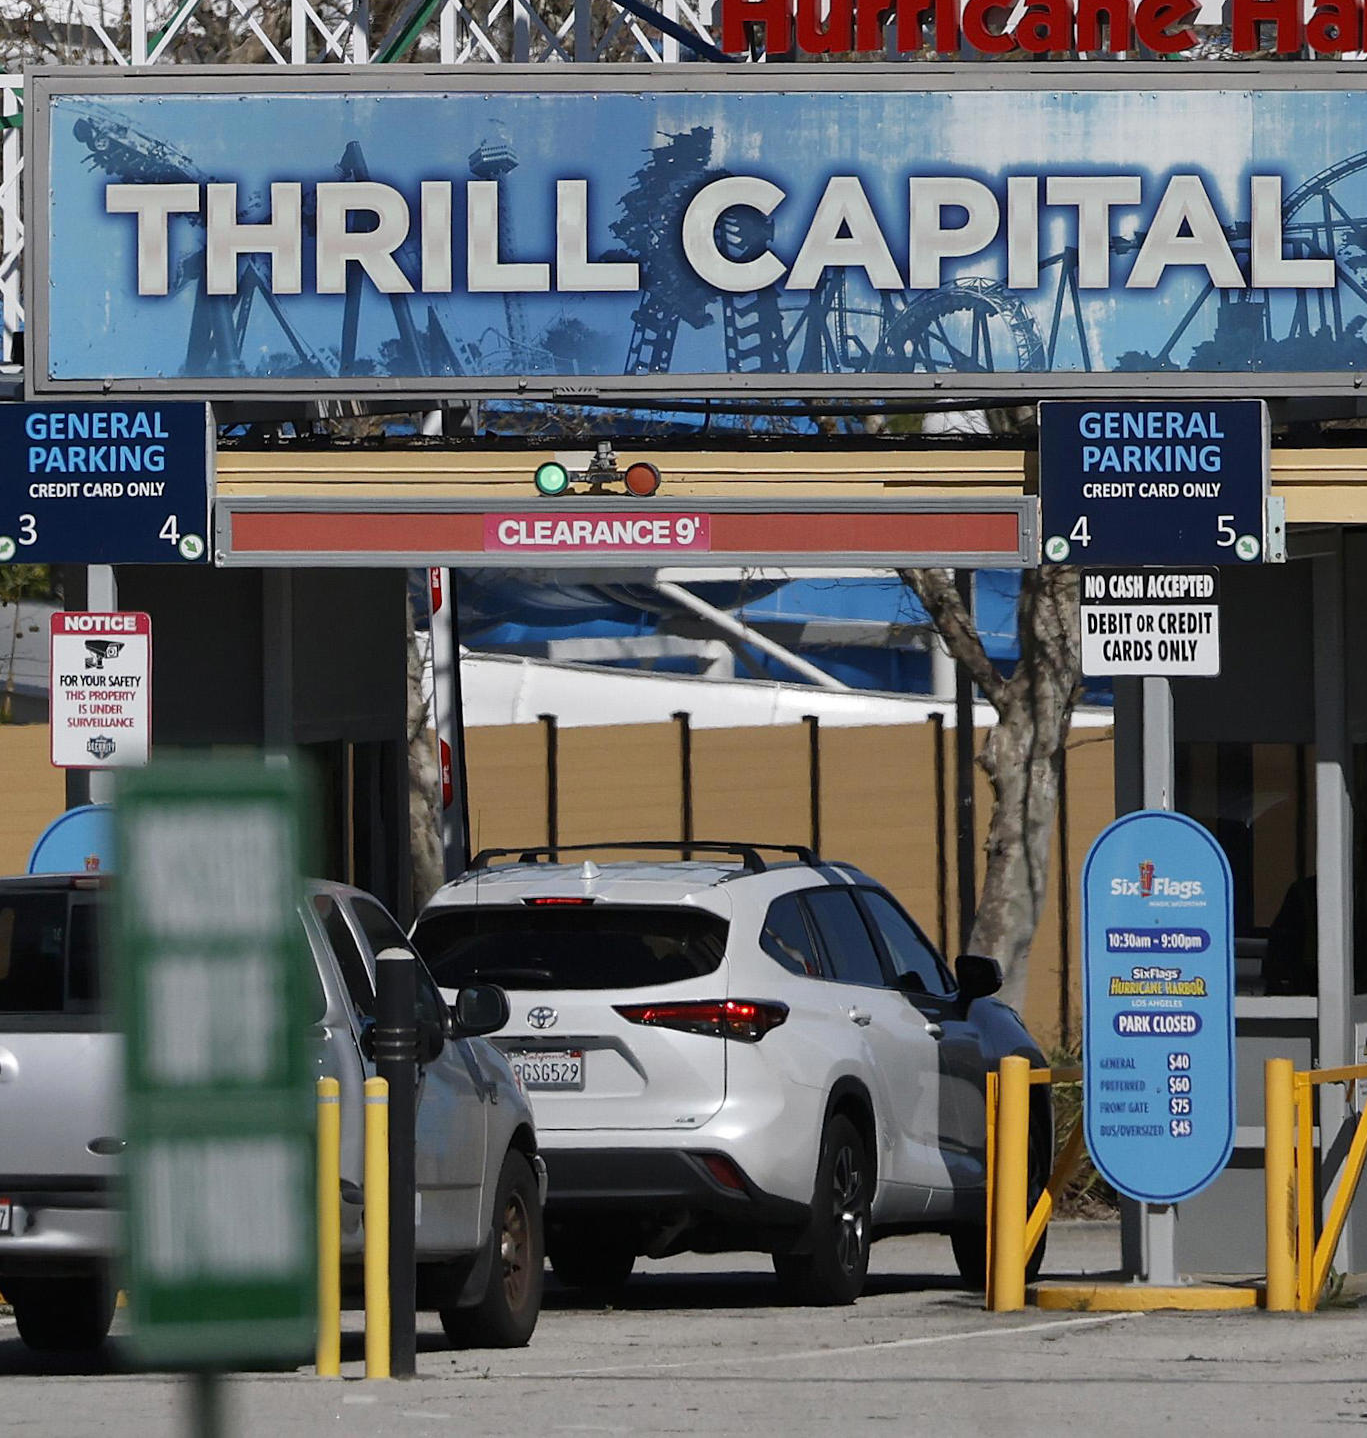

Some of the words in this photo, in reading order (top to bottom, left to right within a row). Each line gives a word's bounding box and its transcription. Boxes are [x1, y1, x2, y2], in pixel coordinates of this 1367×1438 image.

[104, 177, 641, 297] THRILL
[681, 174, 1335, 292] CAPITAL
[25, 412, 169, 440] GENERAL
[1079, 412, 1225, 439] GENERAL
[28, 445, 165, 473] PARKING
[1082, 445, 1222, 473] PARKING
[29, 482, 81, 498] CREDIT
[83, 482, 124, 497] CARD
[126, 482, 165, 497] ONLY
[1083, 483, 1136, 498] CREDIT
[1139, 483, 1180, 498] CARD
[1183, 483, 1221, 498] ONLY
[18, 514, 37, 546] 3
[159, 514, 180, 546] 4
[498, 519, 671, 545] CLEARANCE
[675, 517, 700, 545] 9'
[1069, 516, 1091, 547] 4
[1216, 515, 1236, 547] 5
[1085, 575, 1105, 599] NO
[1108, 575, 1144, 598] CASH
[1146, 575, 1214, 598] ACCEPTED
[64, 616, 137, 632] NOTICE
[1087, 613, 1133, 634] DEBIT
[1137, 615, 1154, 633] OR
[1158, 612, 1212, 634] CREDIT
[1103, 640, 1153, 662] CARDS
[1158, 640, 1198, 662] ONLY
[60, 675, 78, 687] FOR
[80, 675, 106, 687] YOUR
[108, 675, 142, 688] SAFETY
[65, 690, 86, 701] THIS
[89, 690, 136, 701] PROPERTY
[78, 704, 88, 714] IS
[89, 704, 123, 714] UNDER
[67, 717, 135, 728] SURVEILLANCE
[1111, 878, 1140, 897] Six
[1153, 877, 1202, 900] Flags
[1109, 933, 1151, 949] 10:30am
[1161, 933, 1202, 950] 9:00pm
[1111, 978, 1163, 995] HURRICANE
[1165, 978, 1205, 995] HARBOR
[1132, 1000, 1146, 1008] LOS
[1118, 1015, 1151, 1032] PARK
[1152, 1015, 1196, 1033] CLOSED
[1100, 1058, 1136, 1069] GENERAL
[1169, 1054, 1190, 1070] $40
[1169, 1077, 1190, 1094] $60
[1100, 1102, 1127, 1113] FRONT
[1128, 1102, 1149, 1113] GATE
[1171, 1098, 1190, 1114] $75
[1171, 1120, 1191, 1137] $45
